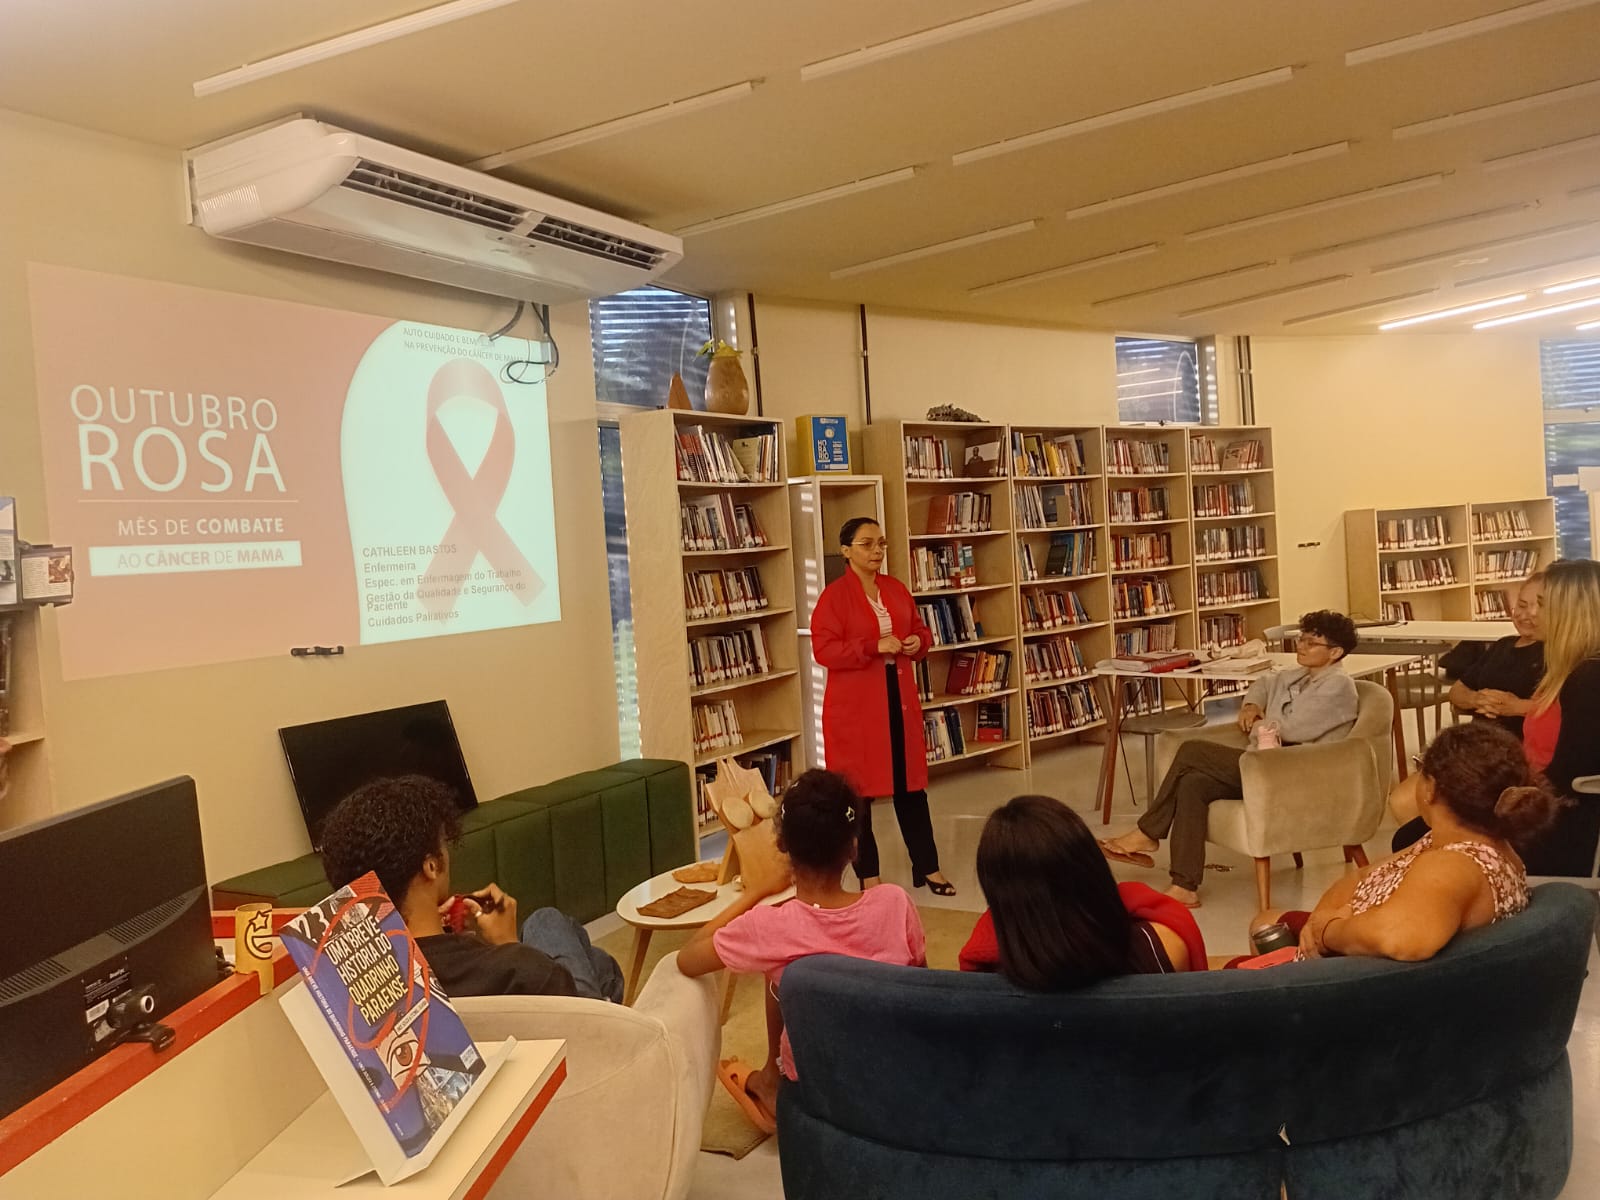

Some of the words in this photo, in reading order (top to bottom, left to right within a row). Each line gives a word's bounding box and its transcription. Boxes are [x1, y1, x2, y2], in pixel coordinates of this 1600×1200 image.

[403, 327, 423, 337] AUTO
[424, 331, 455, 342] CUIDADO
[404, 341, 414, 349] NA
[416, 342, 456, 355] PREVENÇÃO
[468, 350, 493, 361] CÂNCER
[70, 384, 278, 432] OUTUBRO
[78, 424, 287, 492] ROSA
[118, 516, 158, 536] MÊS
[165, 519, 190, 535] DE
[196, 518, 285, 535] COMBATE
[117, 553, 142, 569] AO
[145, 550, 211, 568] CÂNCER
[214, 551, 234, 565] DE
[237, 548, 285, 563] MAMA
[362, 545, 417, 558] CATHLEEN
[418, 544, 457, 555] BASTOS
[363, 562, 417, 573] Enfermeira
[364, 579, 398, 590] Espec.
[400, 577, 415, 586] em
[417, 572, 472, 587] Enfermagem
[474, 570, 485, 580] do
[486, 568, 522, 579] Trabalho
[366, 593, 401, 602] Gestão
[403, 590, 415, 600] da
[417, 587, 462, 600] Qualidade
[471, 582, 514, 595] Segurança
[367, 600, 408, 612] Paciente
[368, 615, 414, 627] Cuidados
[416, 609, 459, 623] Paliativos
[325, 936, 353, 966] UMA
[347, 915, 381, 949] BREVE
[336, 939, 381, 986] HISTÓRIA
[374, 932, 393, 955] DO
[348, 954, 400, 1007] QUADRINHO
[359, 974, 409, 1027] PARAENSE
